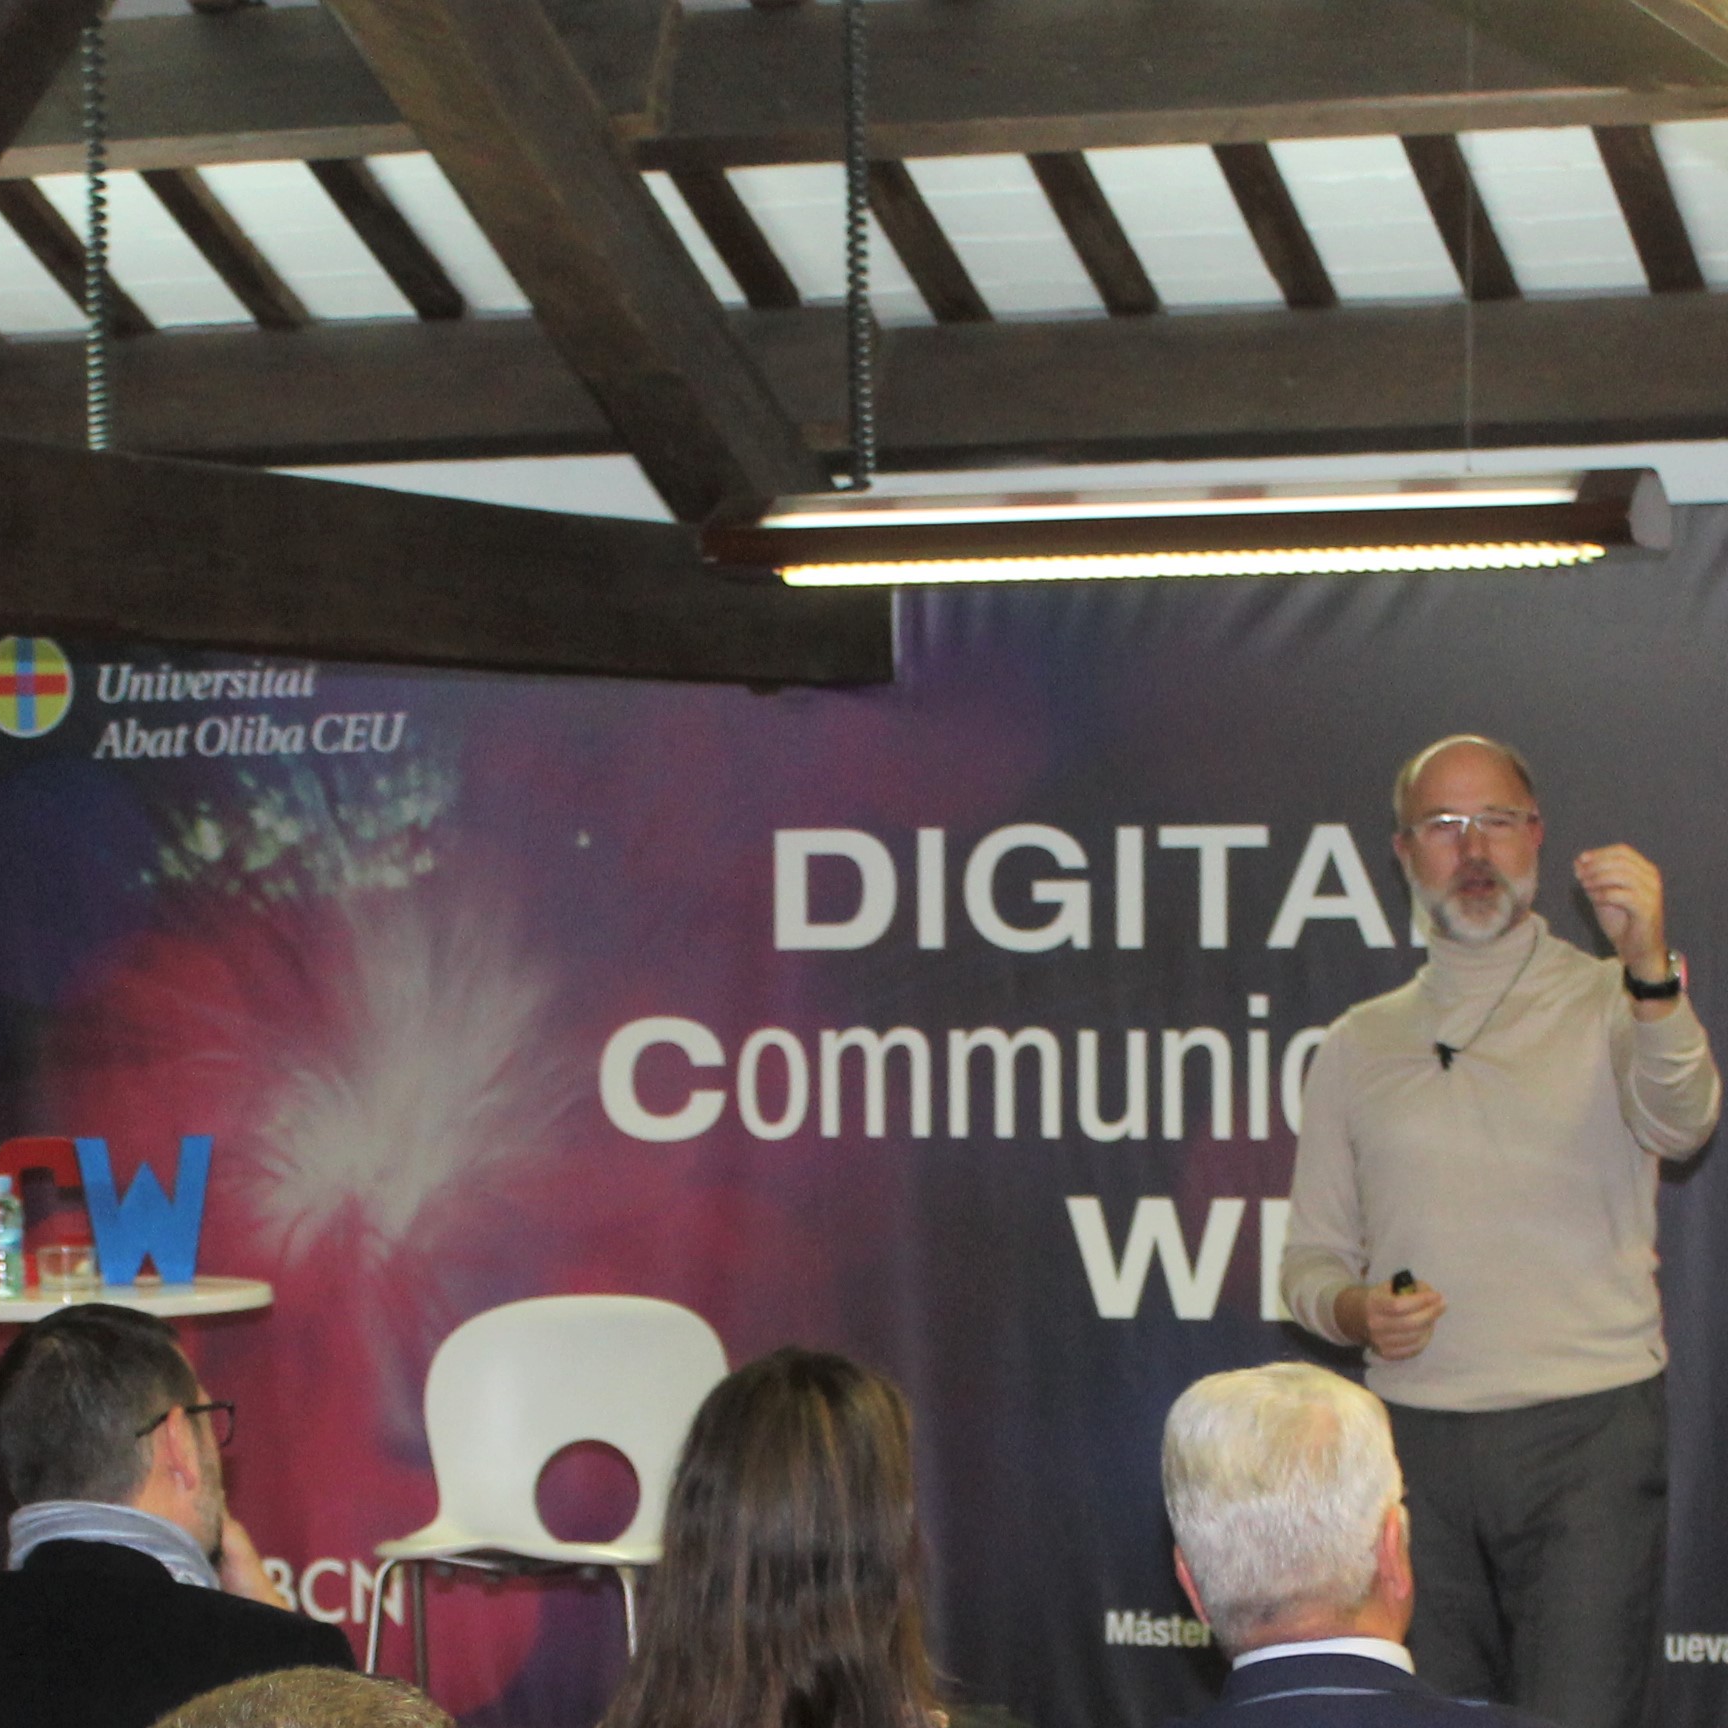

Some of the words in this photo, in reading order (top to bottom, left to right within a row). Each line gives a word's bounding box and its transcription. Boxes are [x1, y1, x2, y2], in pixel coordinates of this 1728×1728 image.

[96, 660, 316, 704] Universitat
[92, 717, 189, 759] Abat
[194, 712, 306, 757] Oliba
[309, 711, 408, 755] CEU
[772, 823, 1429, 952] DIGITA
[598, 993, 1328, 1142] Communic
